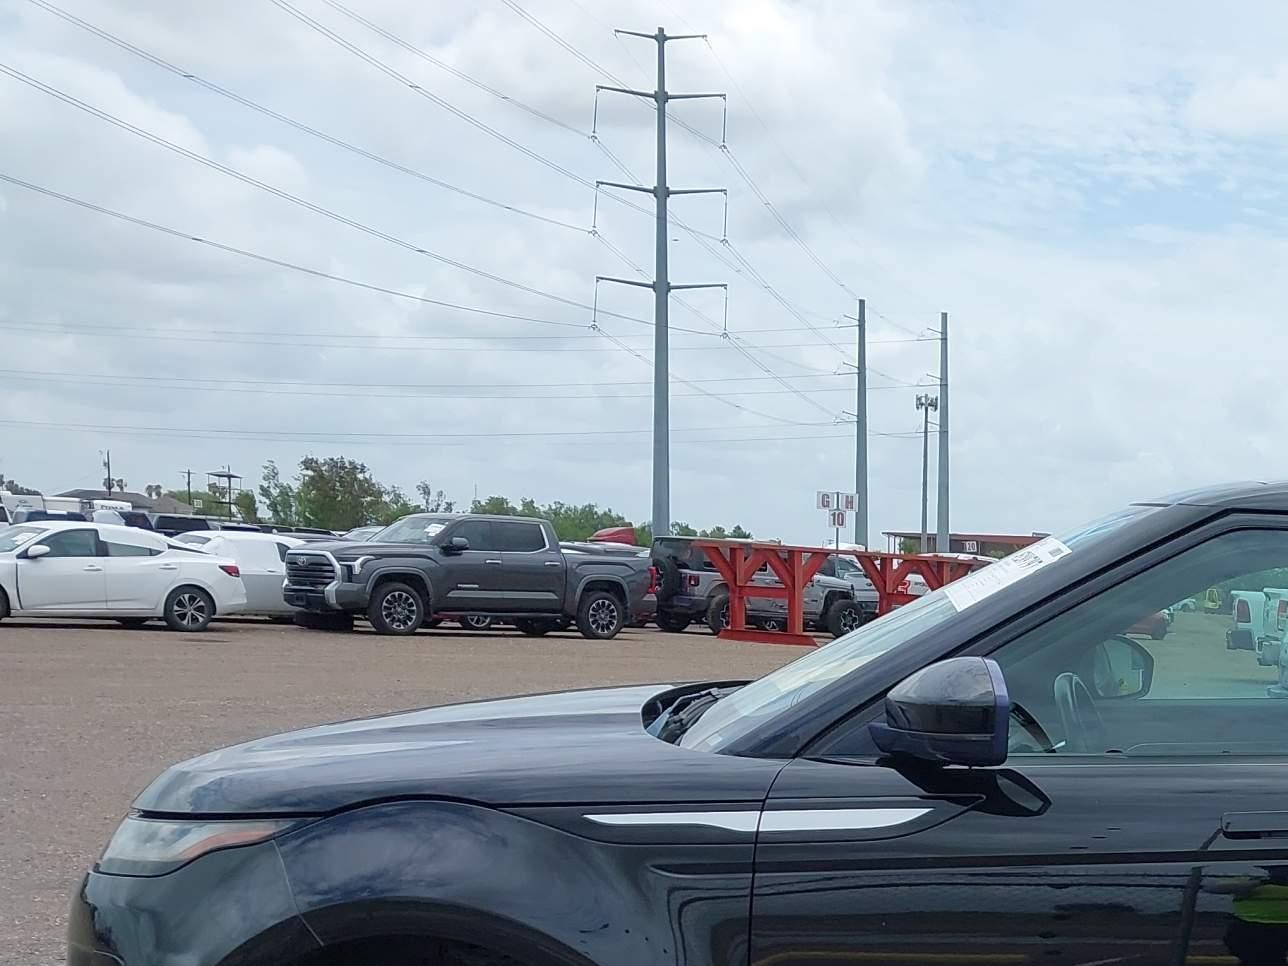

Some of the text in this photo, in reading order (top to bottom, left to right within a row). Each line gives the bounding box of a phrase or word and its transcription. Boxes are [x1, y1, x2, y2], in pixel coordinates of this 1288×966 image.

[821, 493, 830, 508] G
[845, 495, 854, 510] H
[831, 511, 845, 527] 10
